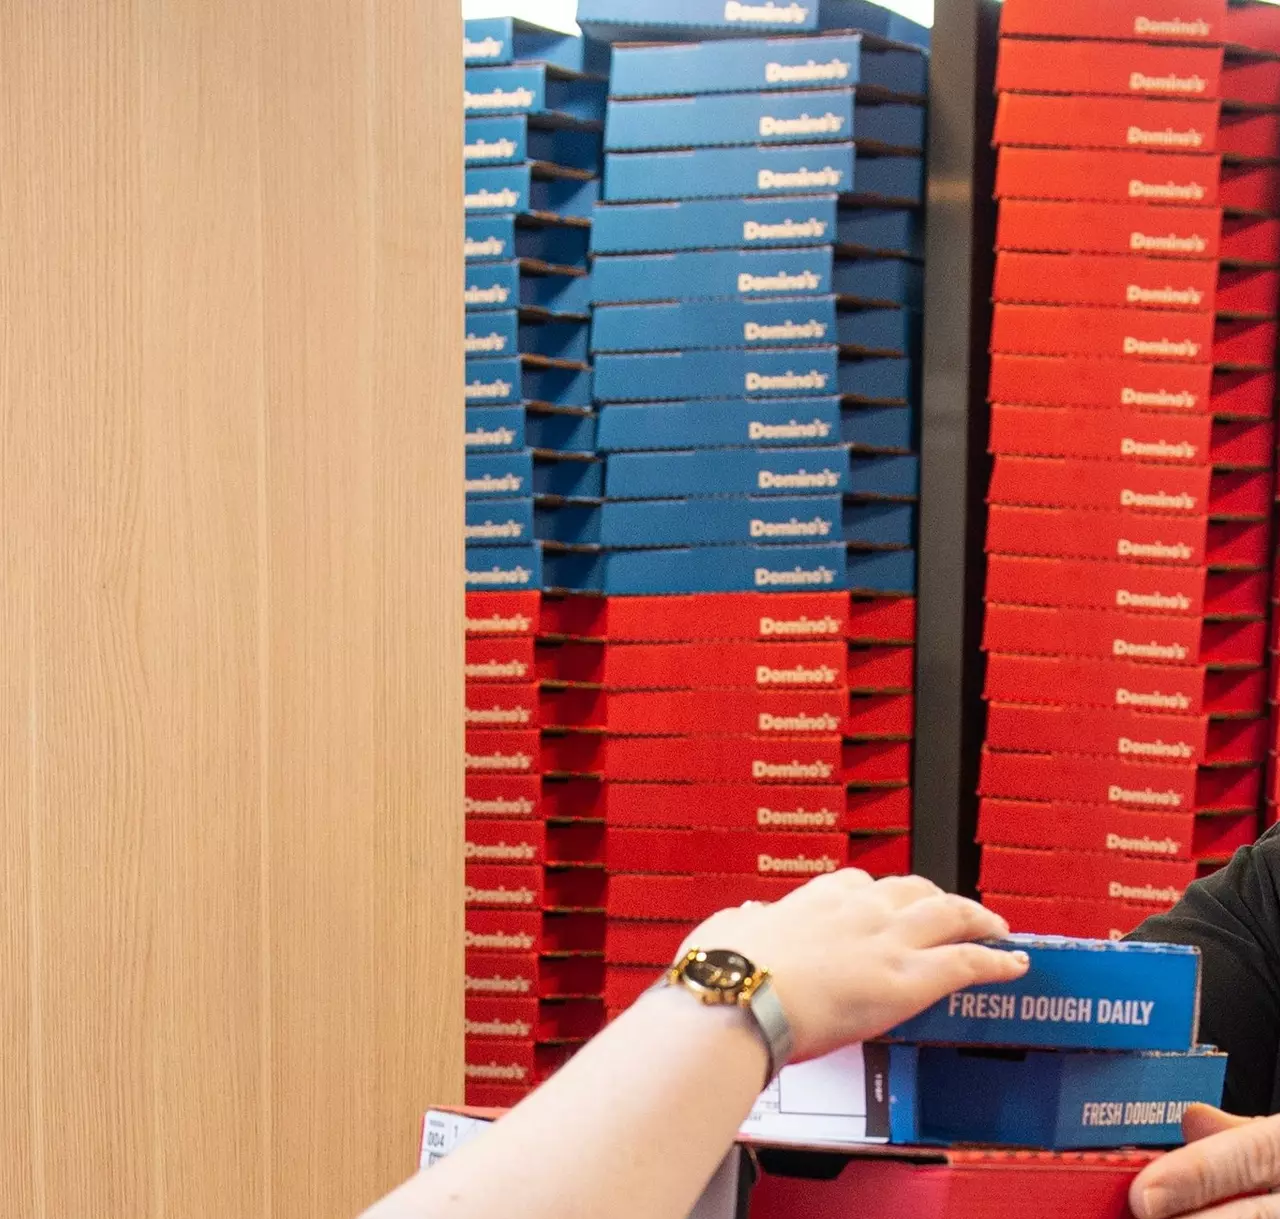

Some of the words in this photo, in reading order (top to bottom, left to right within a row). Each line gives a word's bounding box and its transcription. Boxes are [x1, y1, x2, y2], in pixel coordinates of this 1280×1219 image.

[725, 1, 808, 23] Domino's
[1134, 17, 1209, 35] Domino's
[766, 59, 850, 82] Domino's
[1129, 72, 1205, 92] Domino's
[759, 113, 845, 136] Domino's
[1127, 127, 1202, 146] Domino's
[758, 166, 841, 189] Domino's
[465, 188, 520, 208] mino's
[1128, 180, 1204, 199] Domino's
[743, 218, 828, 240] Domino's
[1130, 232, 1205, 252] Domino's
[737, 270, 821, 292] Domino's
[1127, 285, 1201, 304] Domino's
[744, 320, 827, 341] Domino's
[1123, 337, 1200, 356] Domino's
[745, 370, 828, 391] Domino's
[1121, 388, 1197, 407] Domino's
[748, 419, 832, 440] Domino's
[1121, 438, 1196, 458] Domino's
[465, 473, 523, 492] mino's
[758, 468, 841, 489] Domino's
[1120, 489, 1196, 509] Domino's
[750, 517, 832, 537] Domino's
[1117, 539, 1193, 559] Domino's
[465, 566, 532, 584] omino's
[754, 566, 836, 586] Domino's
[1116, 590, 1191, 609] Domino's
[465, 614, 532, 632] omino's
[760, 616, 842, 635] Domino's
[1113, 639, 1188, 659] Domino's
[465, 660, 528, 677] omino's
[756, 665, 838, 684] Domino's
[1116, 688, 1191, 709] Domino's
[759, 713, 841, 730] Domino's
[1118, 738, 1194, 757] Domino's
[752, 760, 833, 778] Domino's
[1108, 785, 1182, 806] Domino's
[757, 808, 839, 826] Domino's
[1106, 833, 1181, 854] Domino's
[758, 854, 839, 873] Domino's
[949, 993, 1016, 1020] FRESH
[1021, 996, 1092, 1023] DOUGH
[1097, 999, 1155, 1026] DAILY
[1082, 1102, 1122, 1126] FRESH
[1124, 1101, 1164, 1125] DOUGH
